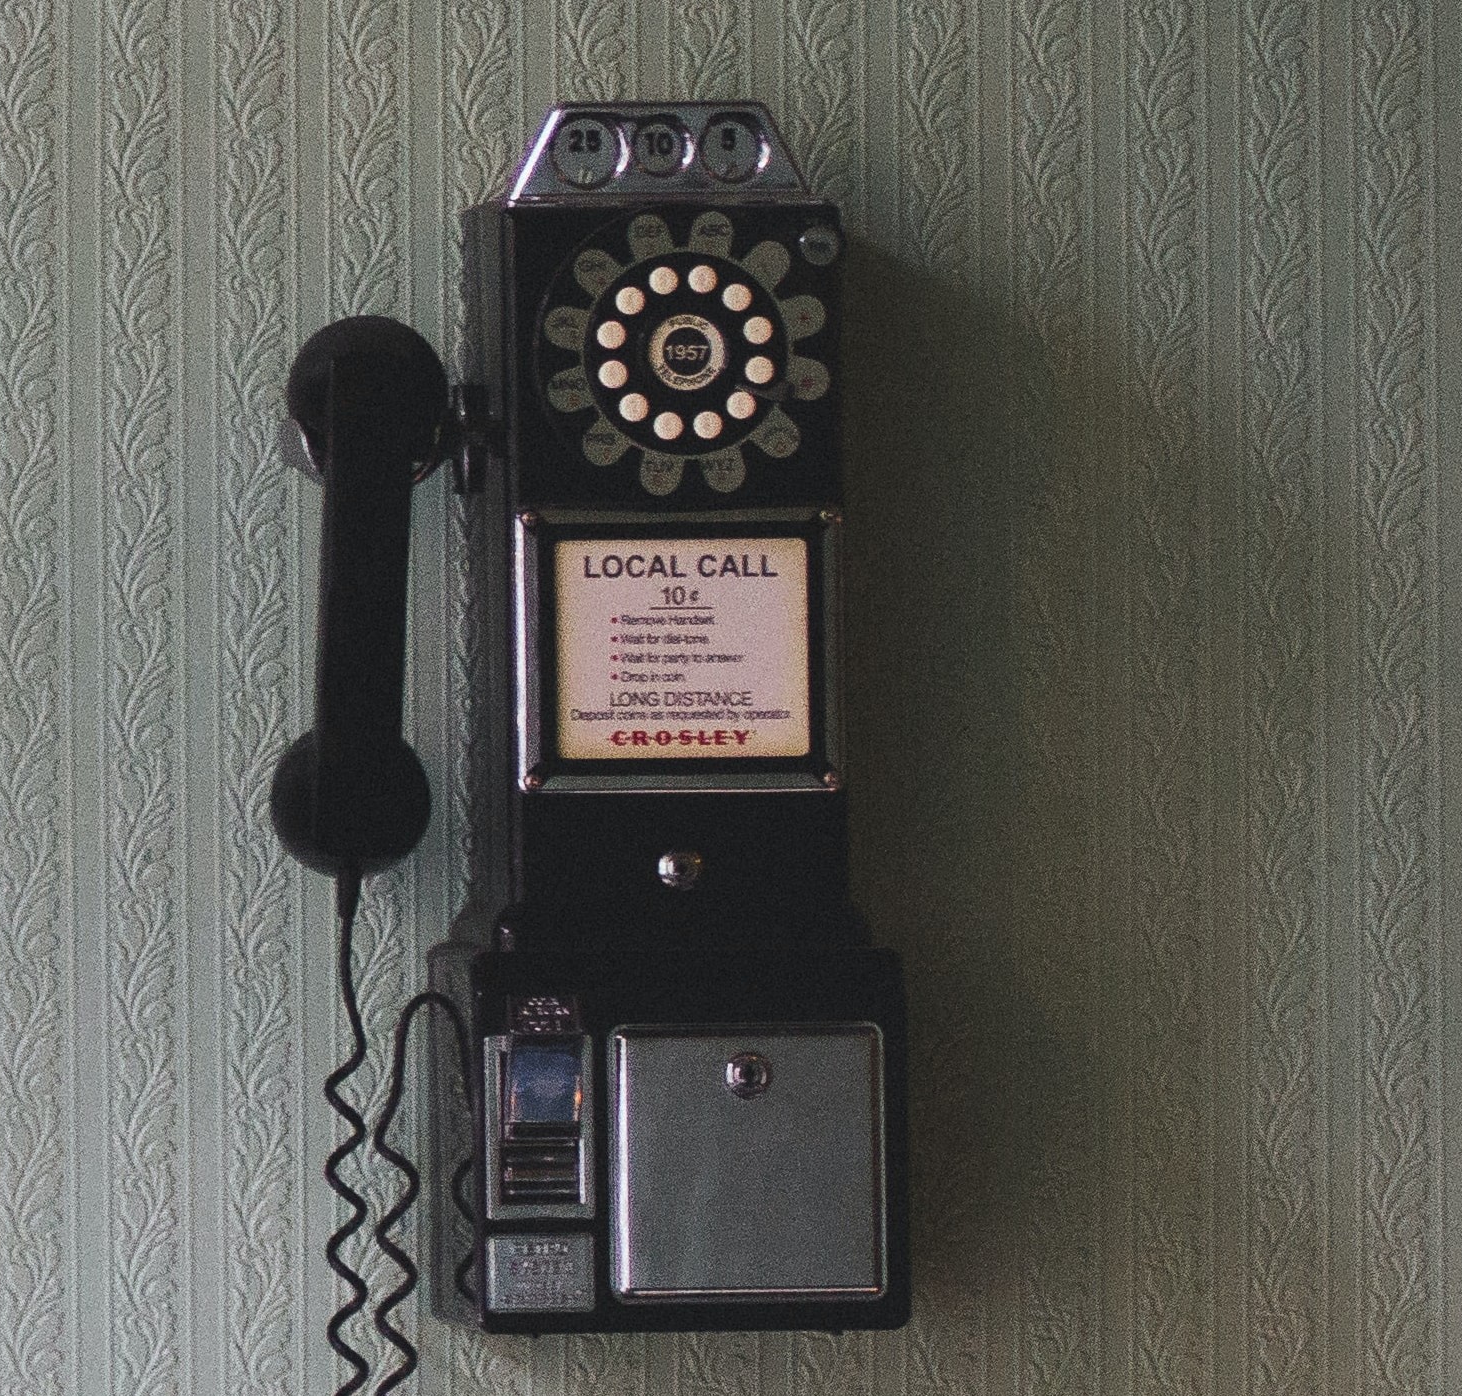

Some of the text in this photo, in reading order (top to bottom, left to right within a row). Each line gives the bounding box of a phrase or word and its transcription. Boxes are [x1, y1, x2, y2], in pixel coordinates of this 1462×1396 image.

[569, 130, 601, 152] 25
[646, 133, 673, 155] 10
[722, 129, 736, 150] 5
[697, 223, 729, 237] ABC
[665, 344, 709, 361] 1957
[583, 555, 779, 578] LOCAL CALL
[662, 586, 685, 605] 10
[620, 614, 665, 626] Remove
[619, 634, 645, 645] Wait
[646, 634, 660, 645] for
[620, 653, 645, 664] Wait
[646, 653, 660, 664] for
[662, 654, 689, 668] party
[692, 654, 703, 664] to
[620, 671, 648, 683] Drop
[649, 673, 659, 682] in
[609, 690, 755, 708] LONG DISTANCE
[570, 708, 613, 722] Deposit
[616, 710, 647, 721] coins
[650, 711, 664, 720] as
[667, 709, 724, 722] requested
[727, 709, 741, 724] by
[609, 729, 752, 748] CROSLEY
